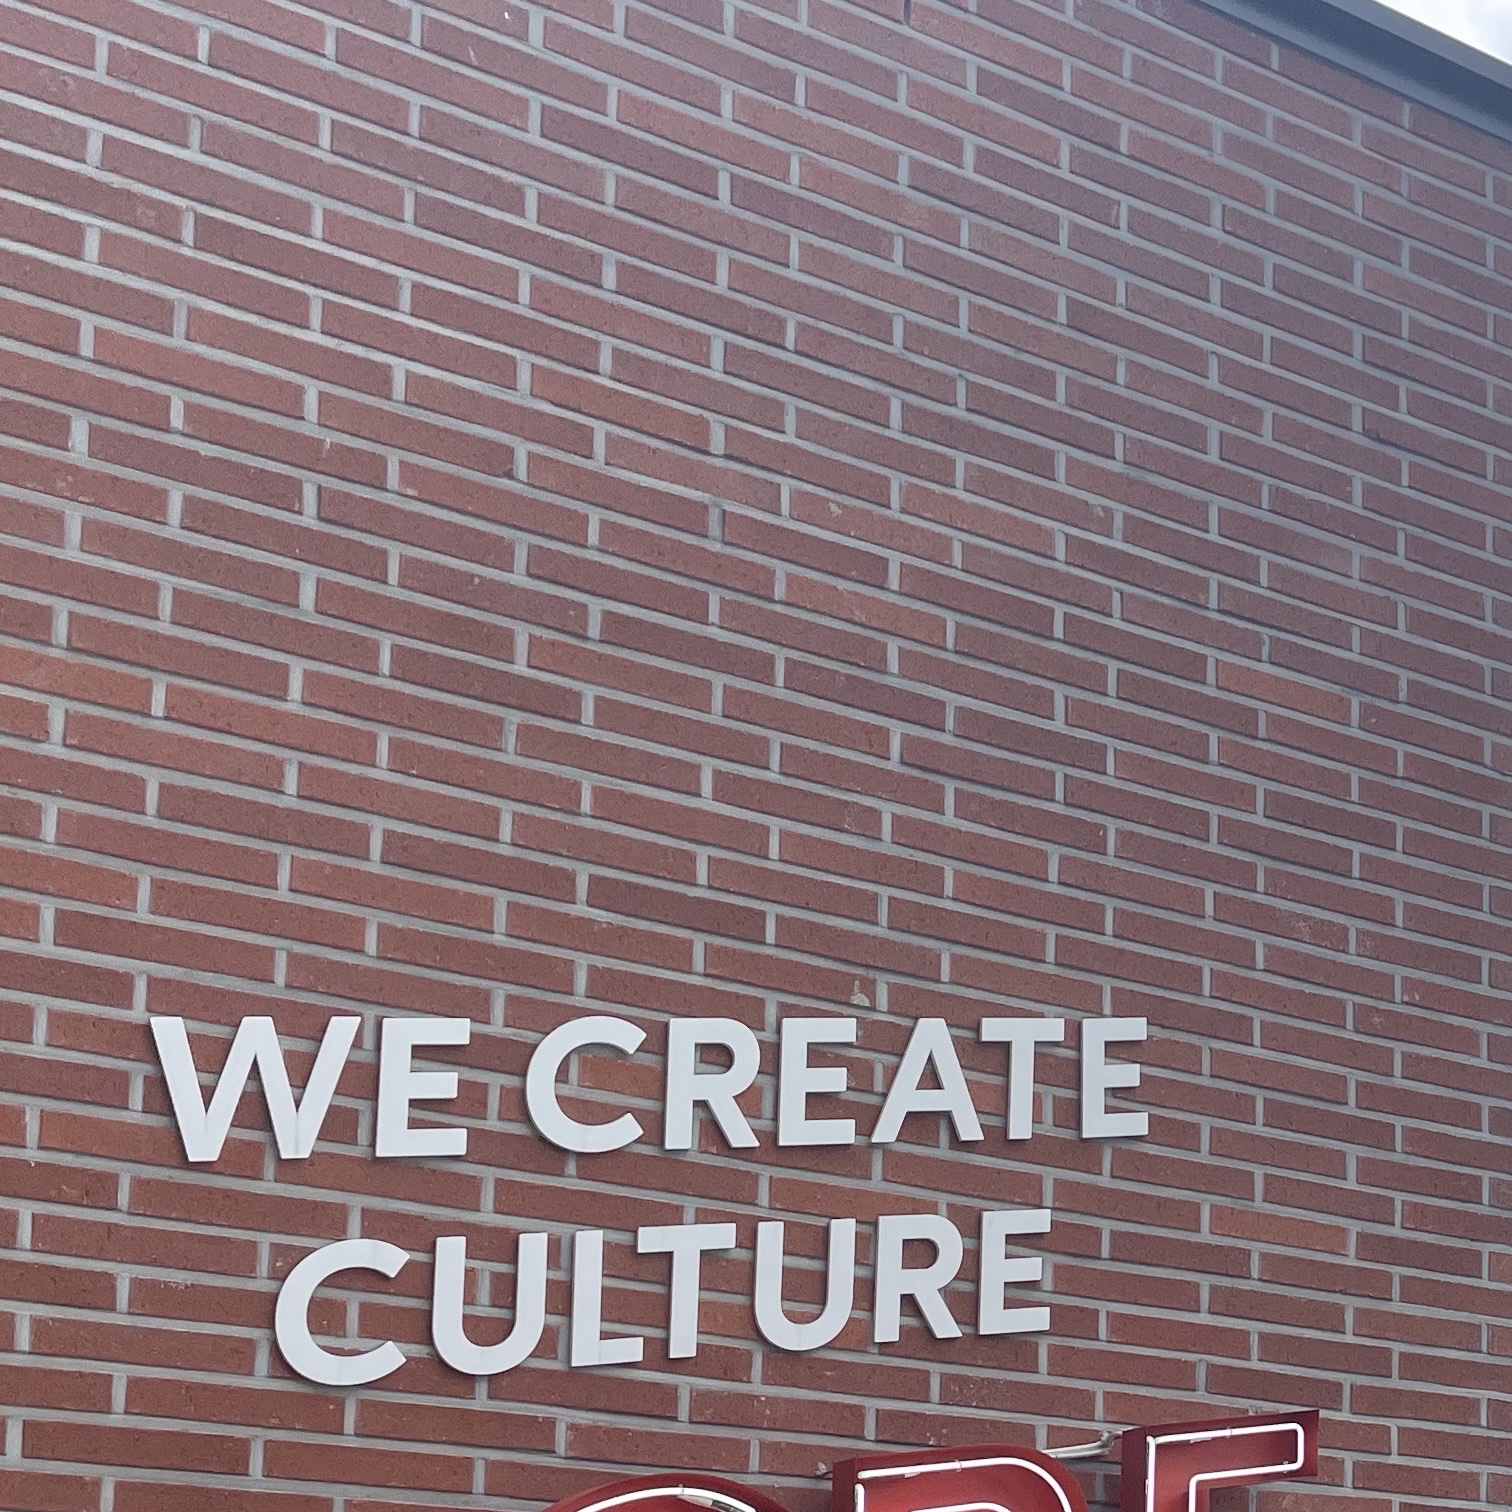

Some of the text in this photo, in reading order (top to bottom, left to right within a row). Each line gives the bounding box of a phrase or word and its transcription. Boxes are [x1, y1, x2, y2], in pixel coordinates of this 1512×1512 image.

[150, 1015, 1148, 1162] WE CREATE
[275, 1209, 1051, 1386] CULTURE
